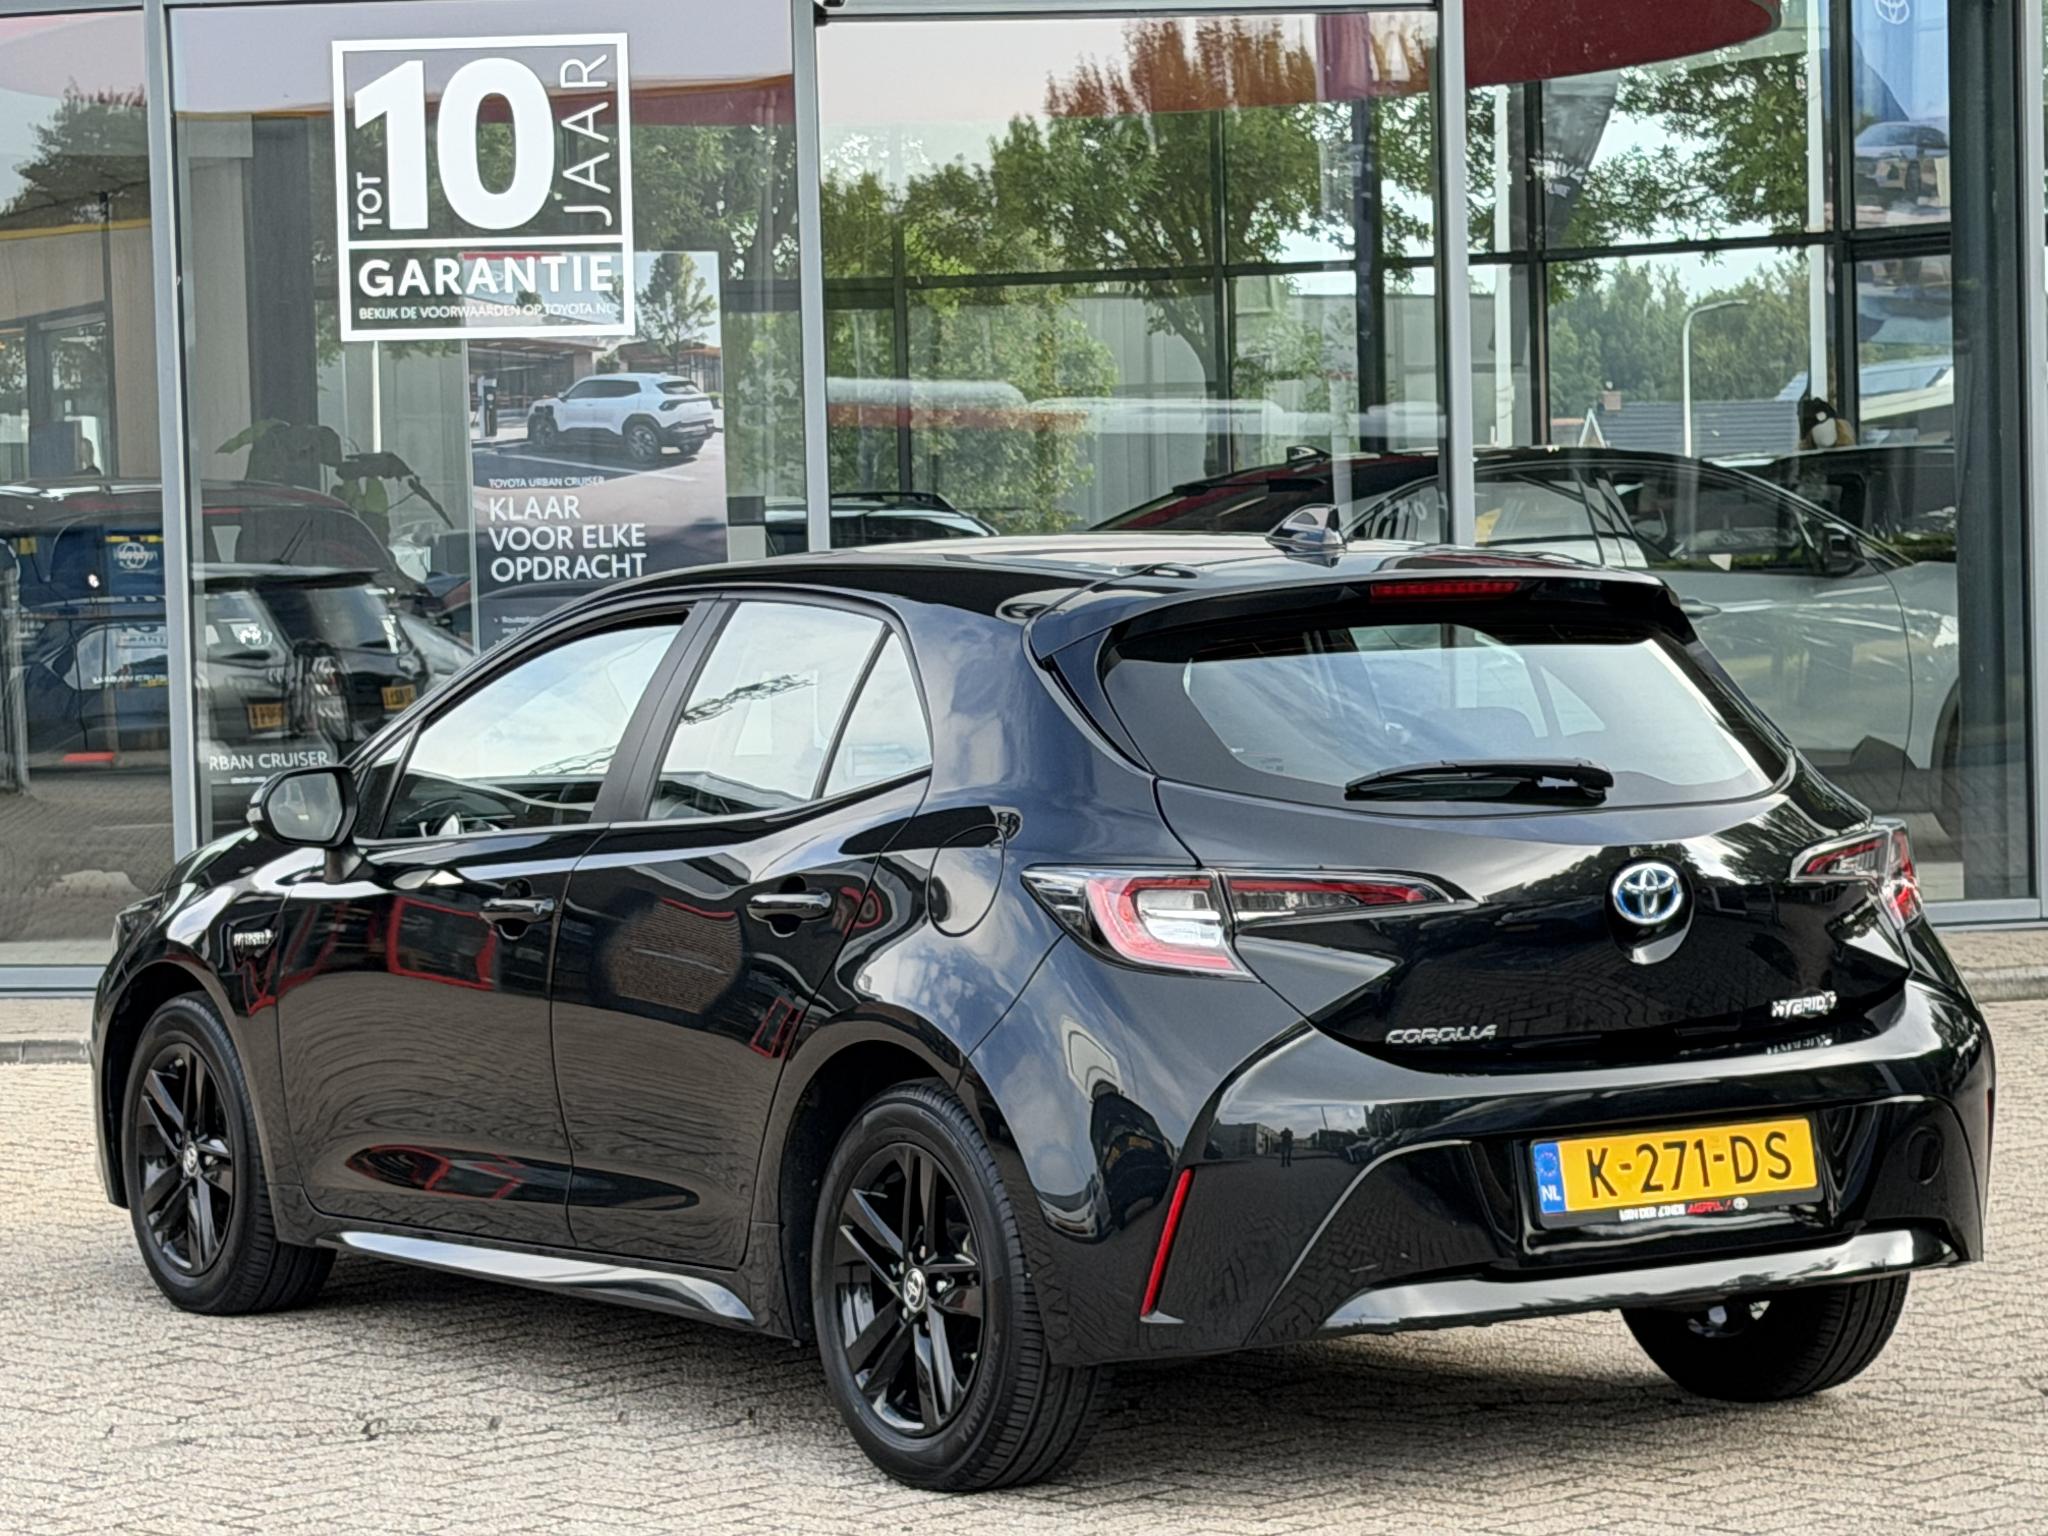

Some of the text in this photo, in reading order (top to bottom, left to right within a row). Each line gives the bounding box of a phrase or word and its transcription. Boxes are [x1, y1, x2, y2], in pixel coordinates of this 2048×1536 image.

[354, 57, 555, 230] 10
[560, 54, 613, 227] JAAR
[356, 171, 383, 231] TOT
[358, 255, 614, 297] GARANTIE
[359, 306, 399, 320] BEKIJK
[400, 305, 418, 319] DE
[420, 304, 520, 319] VOORWAARDEN
[522, 303, 542, 316] OP
[488, 475, 605, 489] TOYOTA URBAN CRUISER
[489, 495, 581, 522] KLAAR
[488, 522, 646, 551] VOOR ELKE
[490, 552, 647, 582] OPDRACHT
[208, 751, 329, 771] RBAN CRUISER
[1385, 1023, 1498, 1045] COROLLA
[1541, 1131, 1792, 1201] NL K-271-DS
